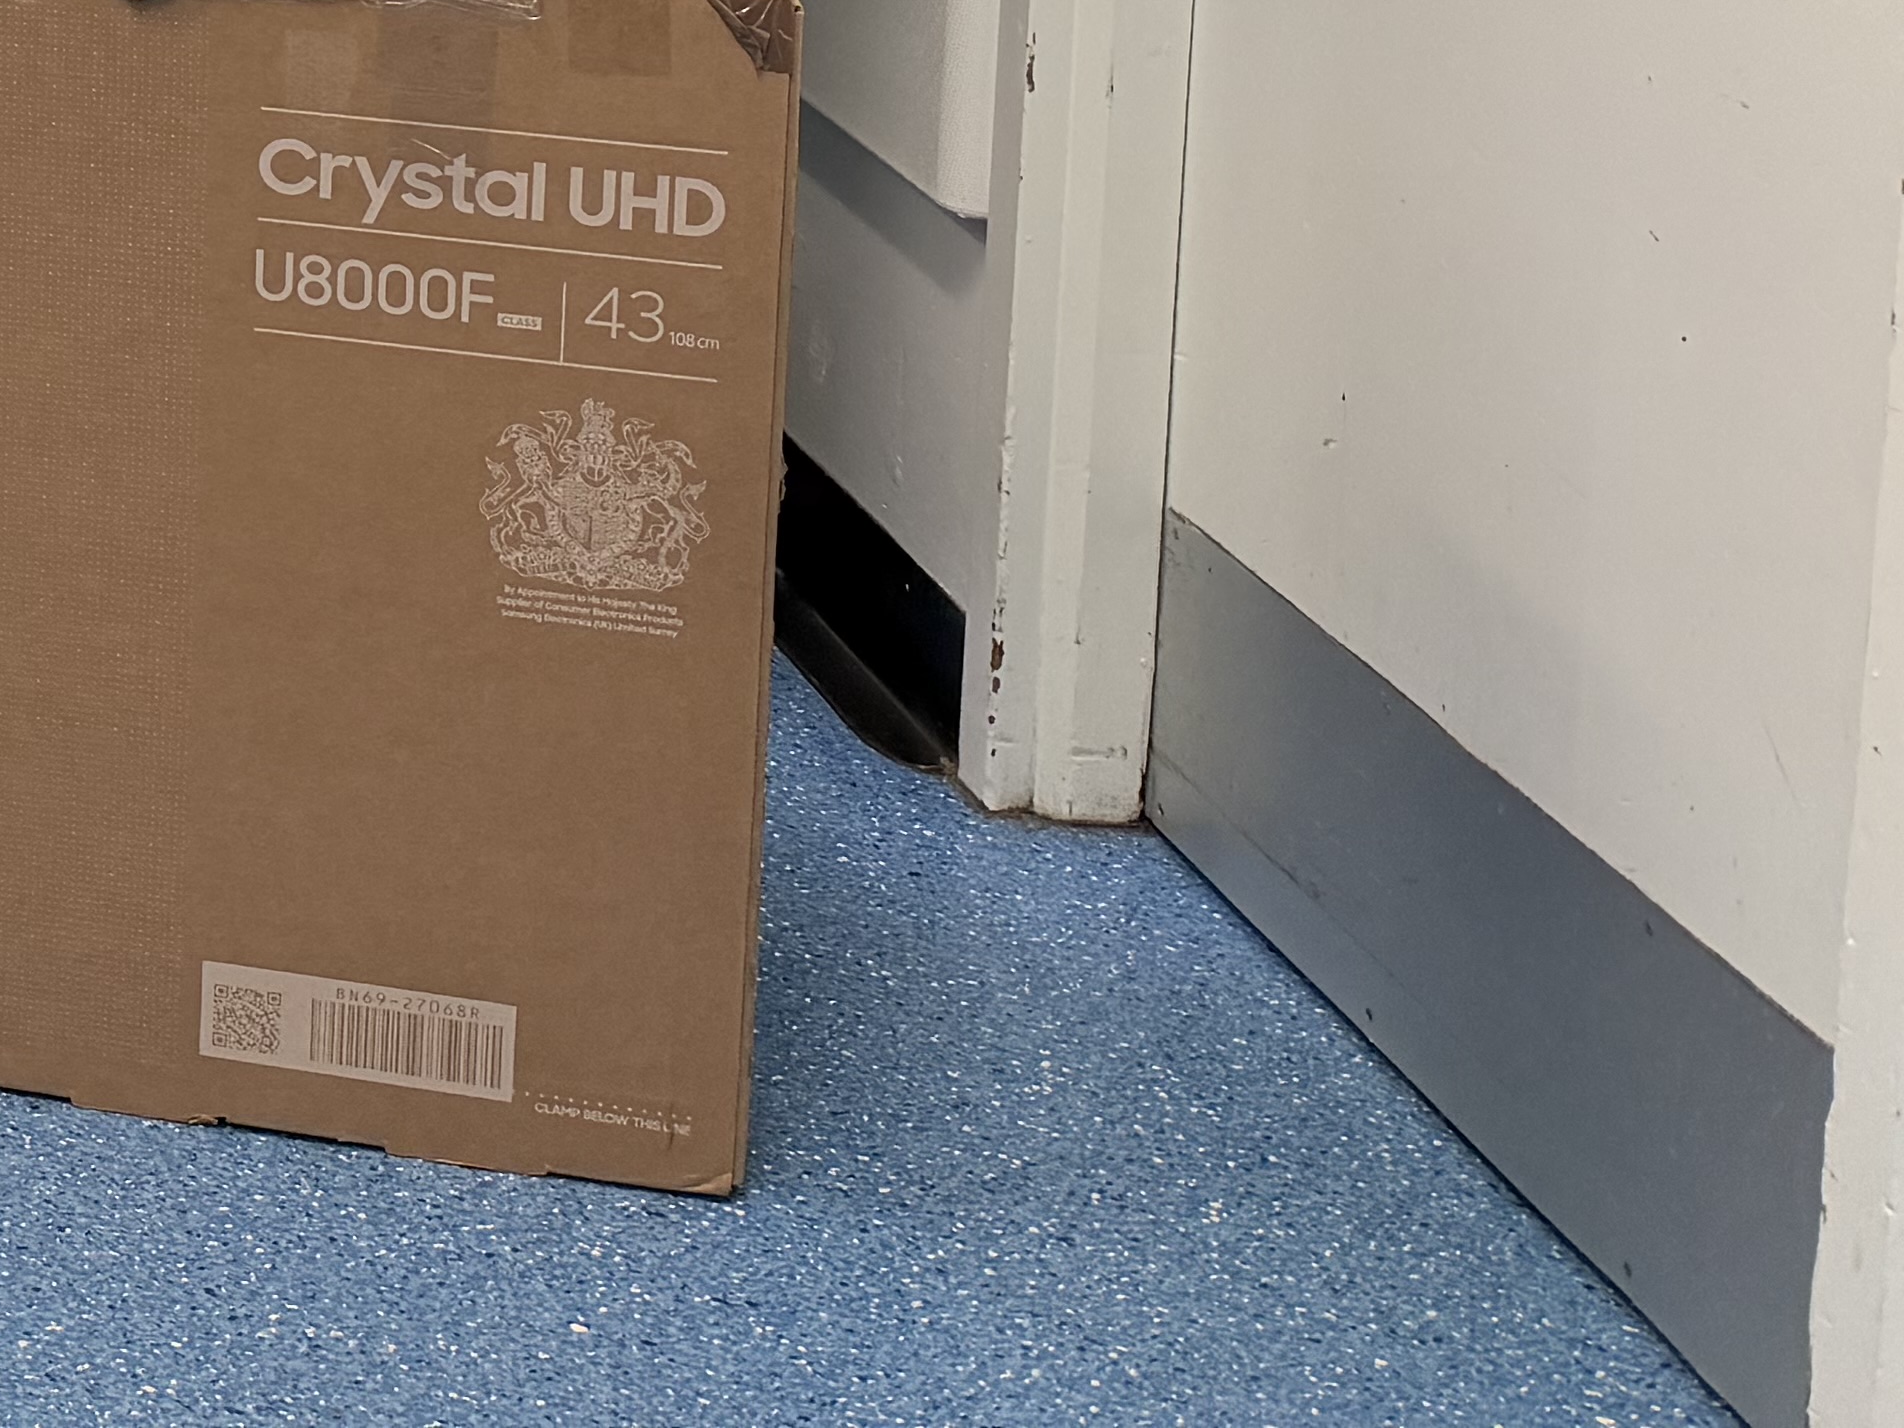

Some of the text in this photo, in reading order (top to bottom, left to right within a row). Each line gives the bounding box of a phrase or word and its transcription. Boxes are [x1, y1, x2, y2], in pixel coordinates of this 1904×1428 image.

[257, 137, 727, 238] Crystal UHD
[253, 248, 496, 324] U8000F
[498, 315, 540, 331] CLASS
[583, 287, 665, 344] 43
[534, 1102, 581, 1118] CLAMP
[583, 1108, 629, 1127] BELOW
[633, 1115, 661, 1132] THIS
